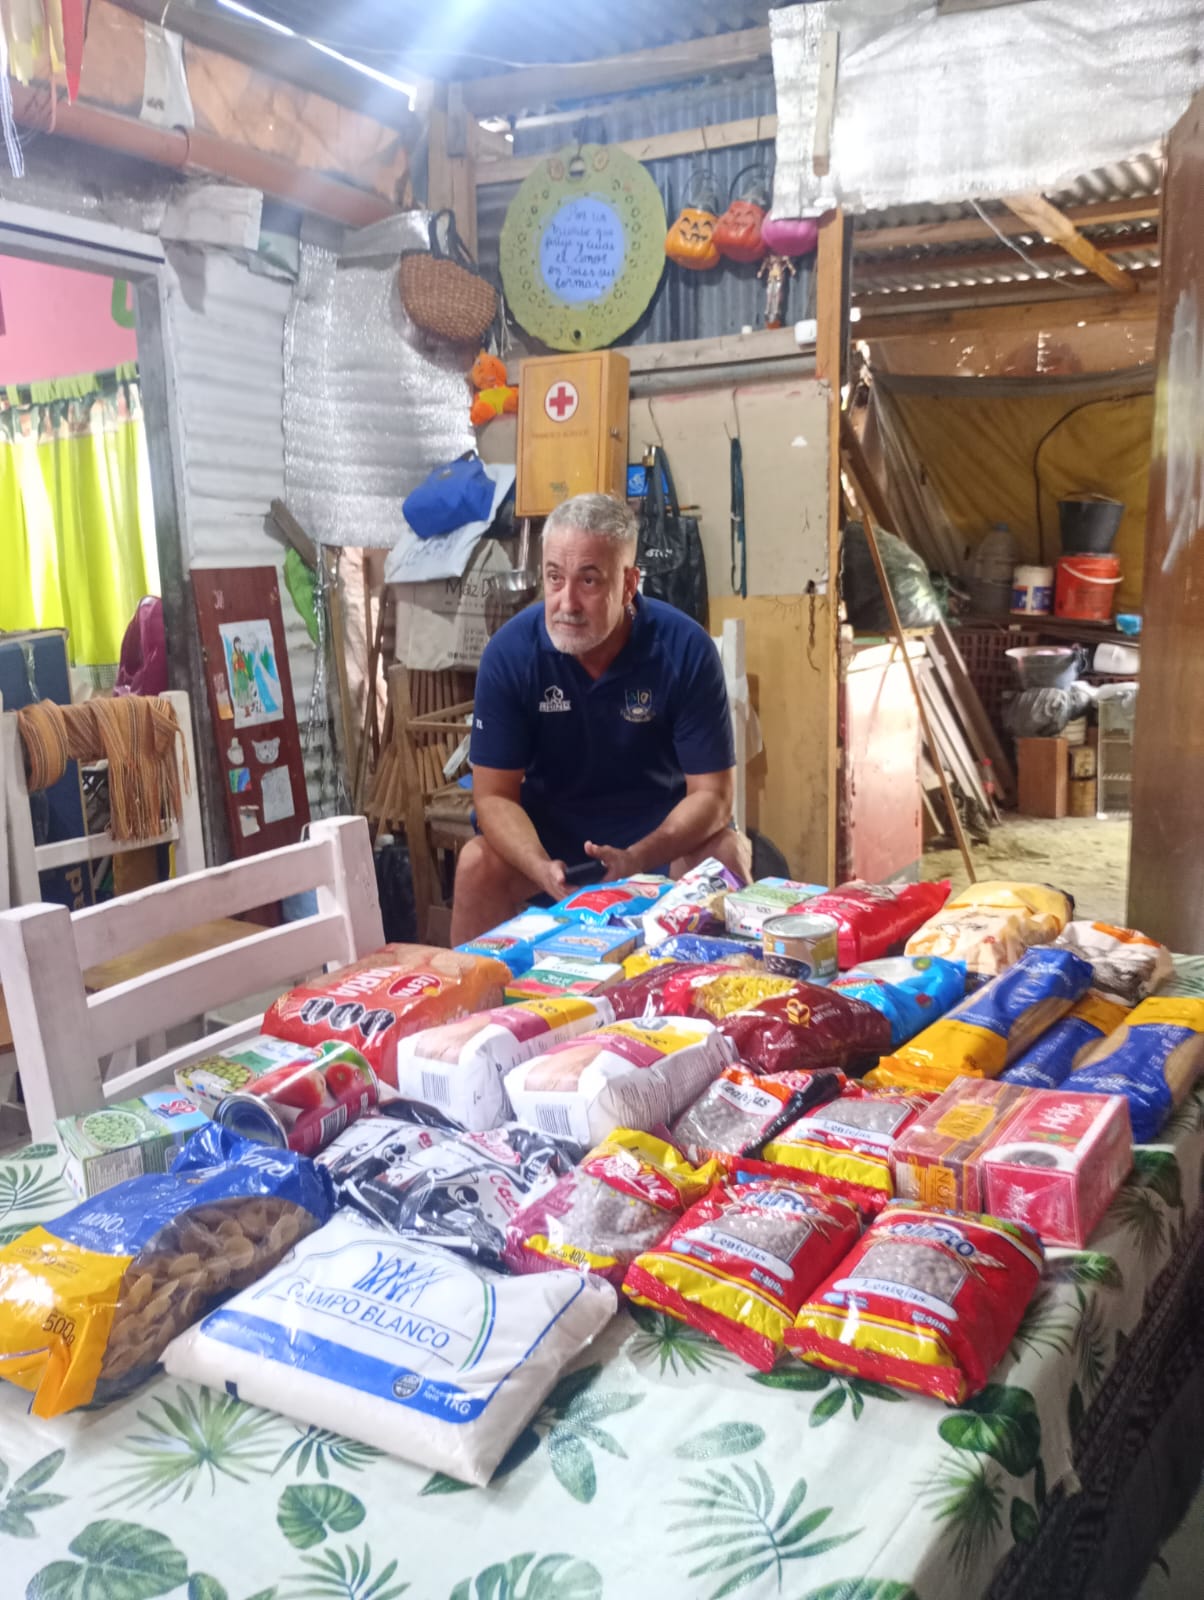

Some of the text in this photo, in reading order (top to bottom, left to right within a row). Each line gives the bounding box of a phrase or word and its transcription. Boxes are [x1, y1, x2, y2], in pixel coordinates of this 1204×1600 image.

[709, 1232, 768, 1262] Lentejas
[860, 1279, 926, 1304] Lentejas
[287, 1280, 450, 1349] CMPO BLANCO
